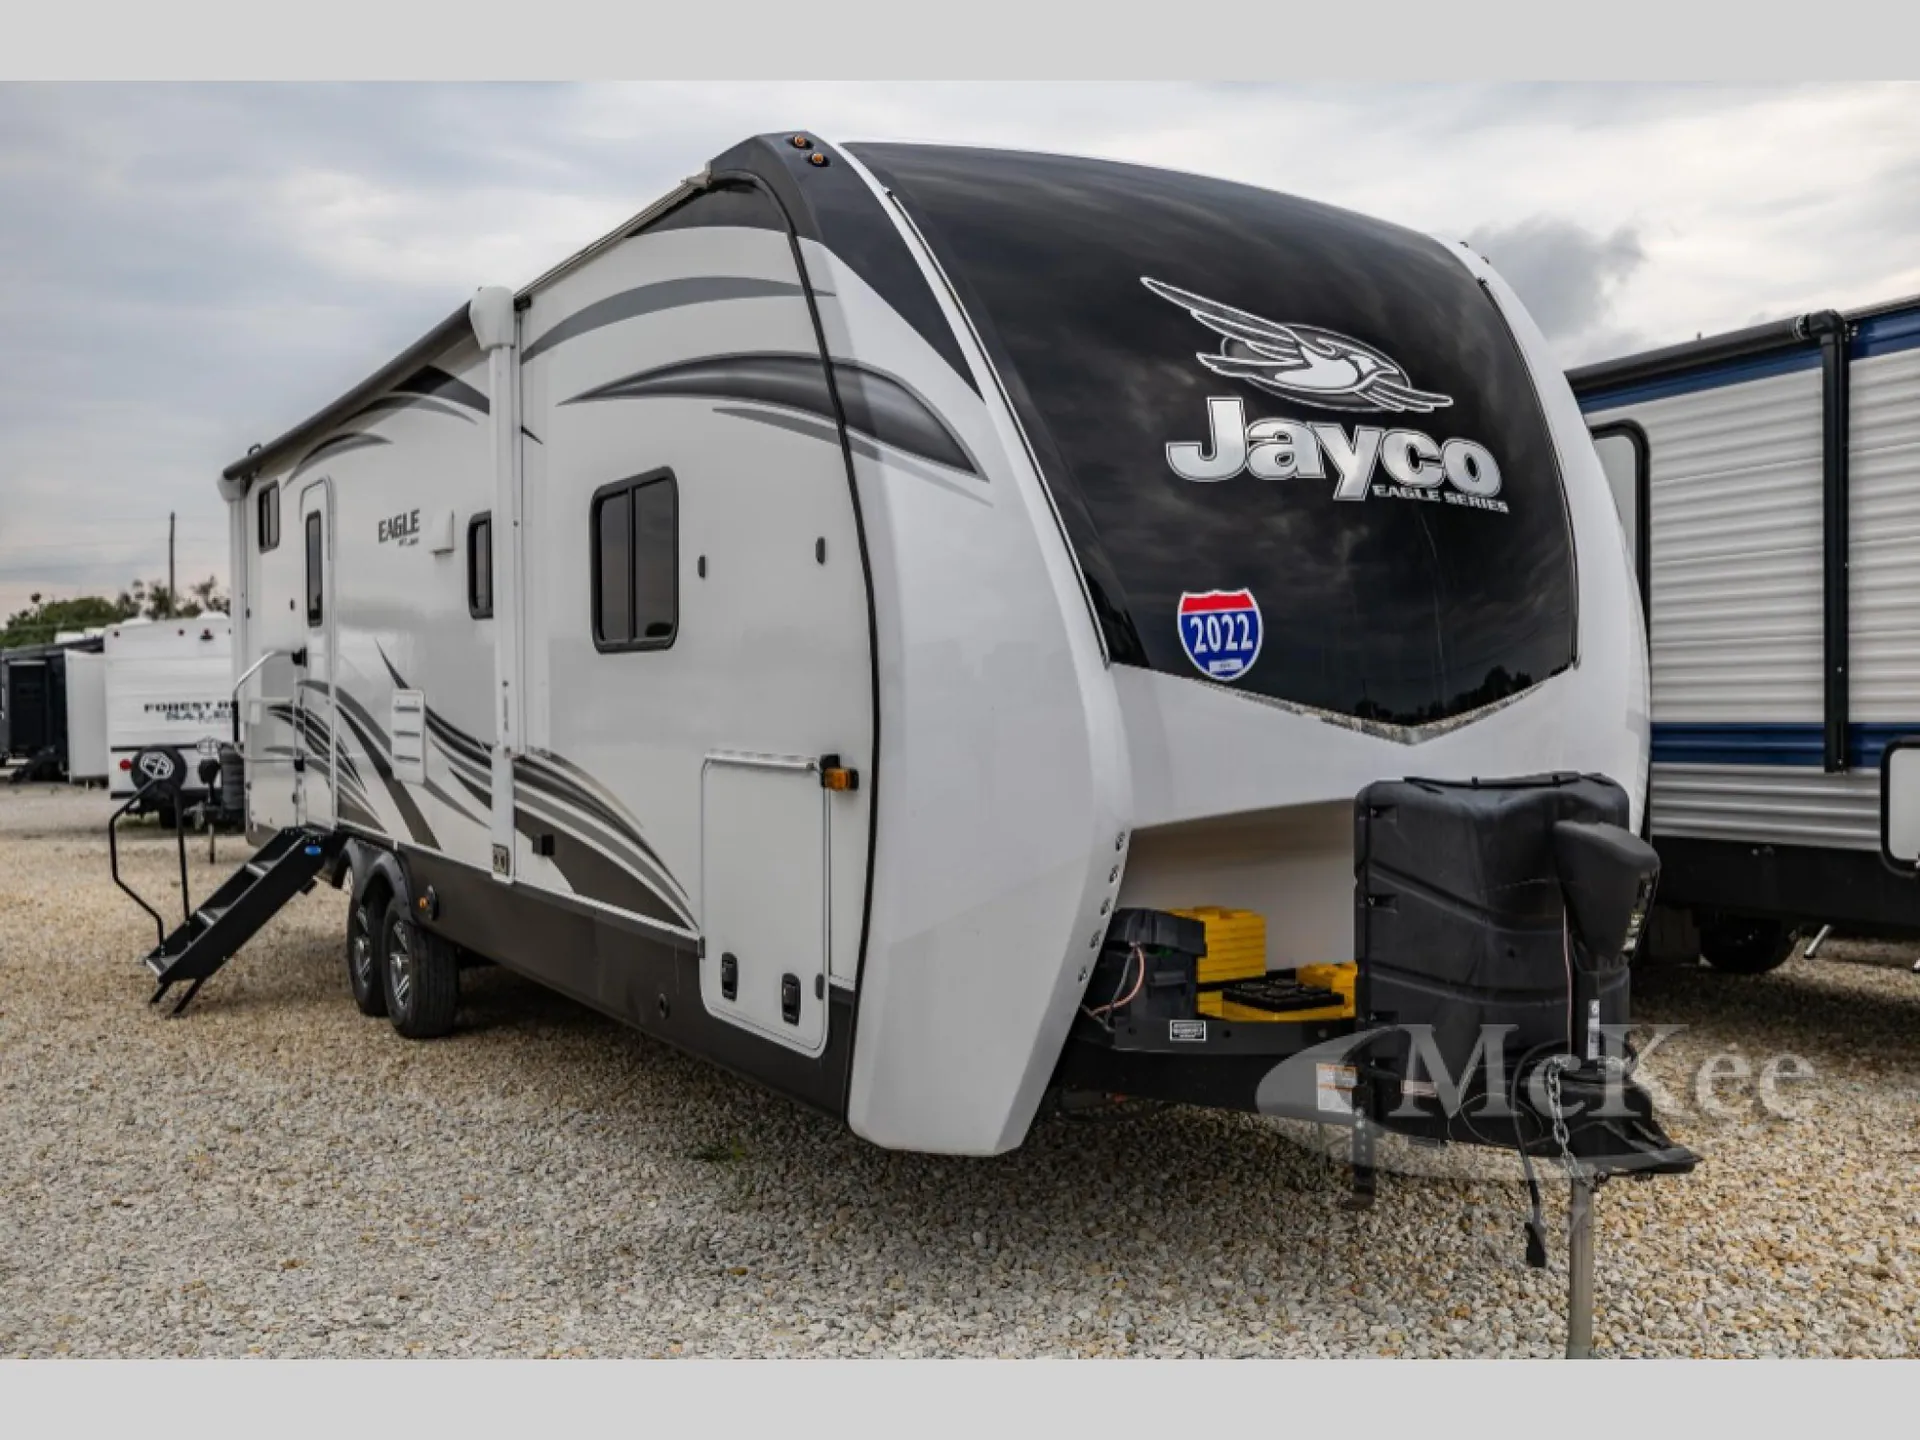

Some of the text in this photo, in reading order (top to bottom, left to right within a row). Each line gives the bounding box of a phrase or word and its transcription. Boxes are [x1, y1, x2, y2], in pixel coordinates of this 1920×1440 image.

[1166, 396, 1501, 501] Jayco
[1372, 484, 1509, 514] EAGLE SERIES
[378, 508, 420, 544] EAGLE
[1189, 612, 1254, 654] 2022
